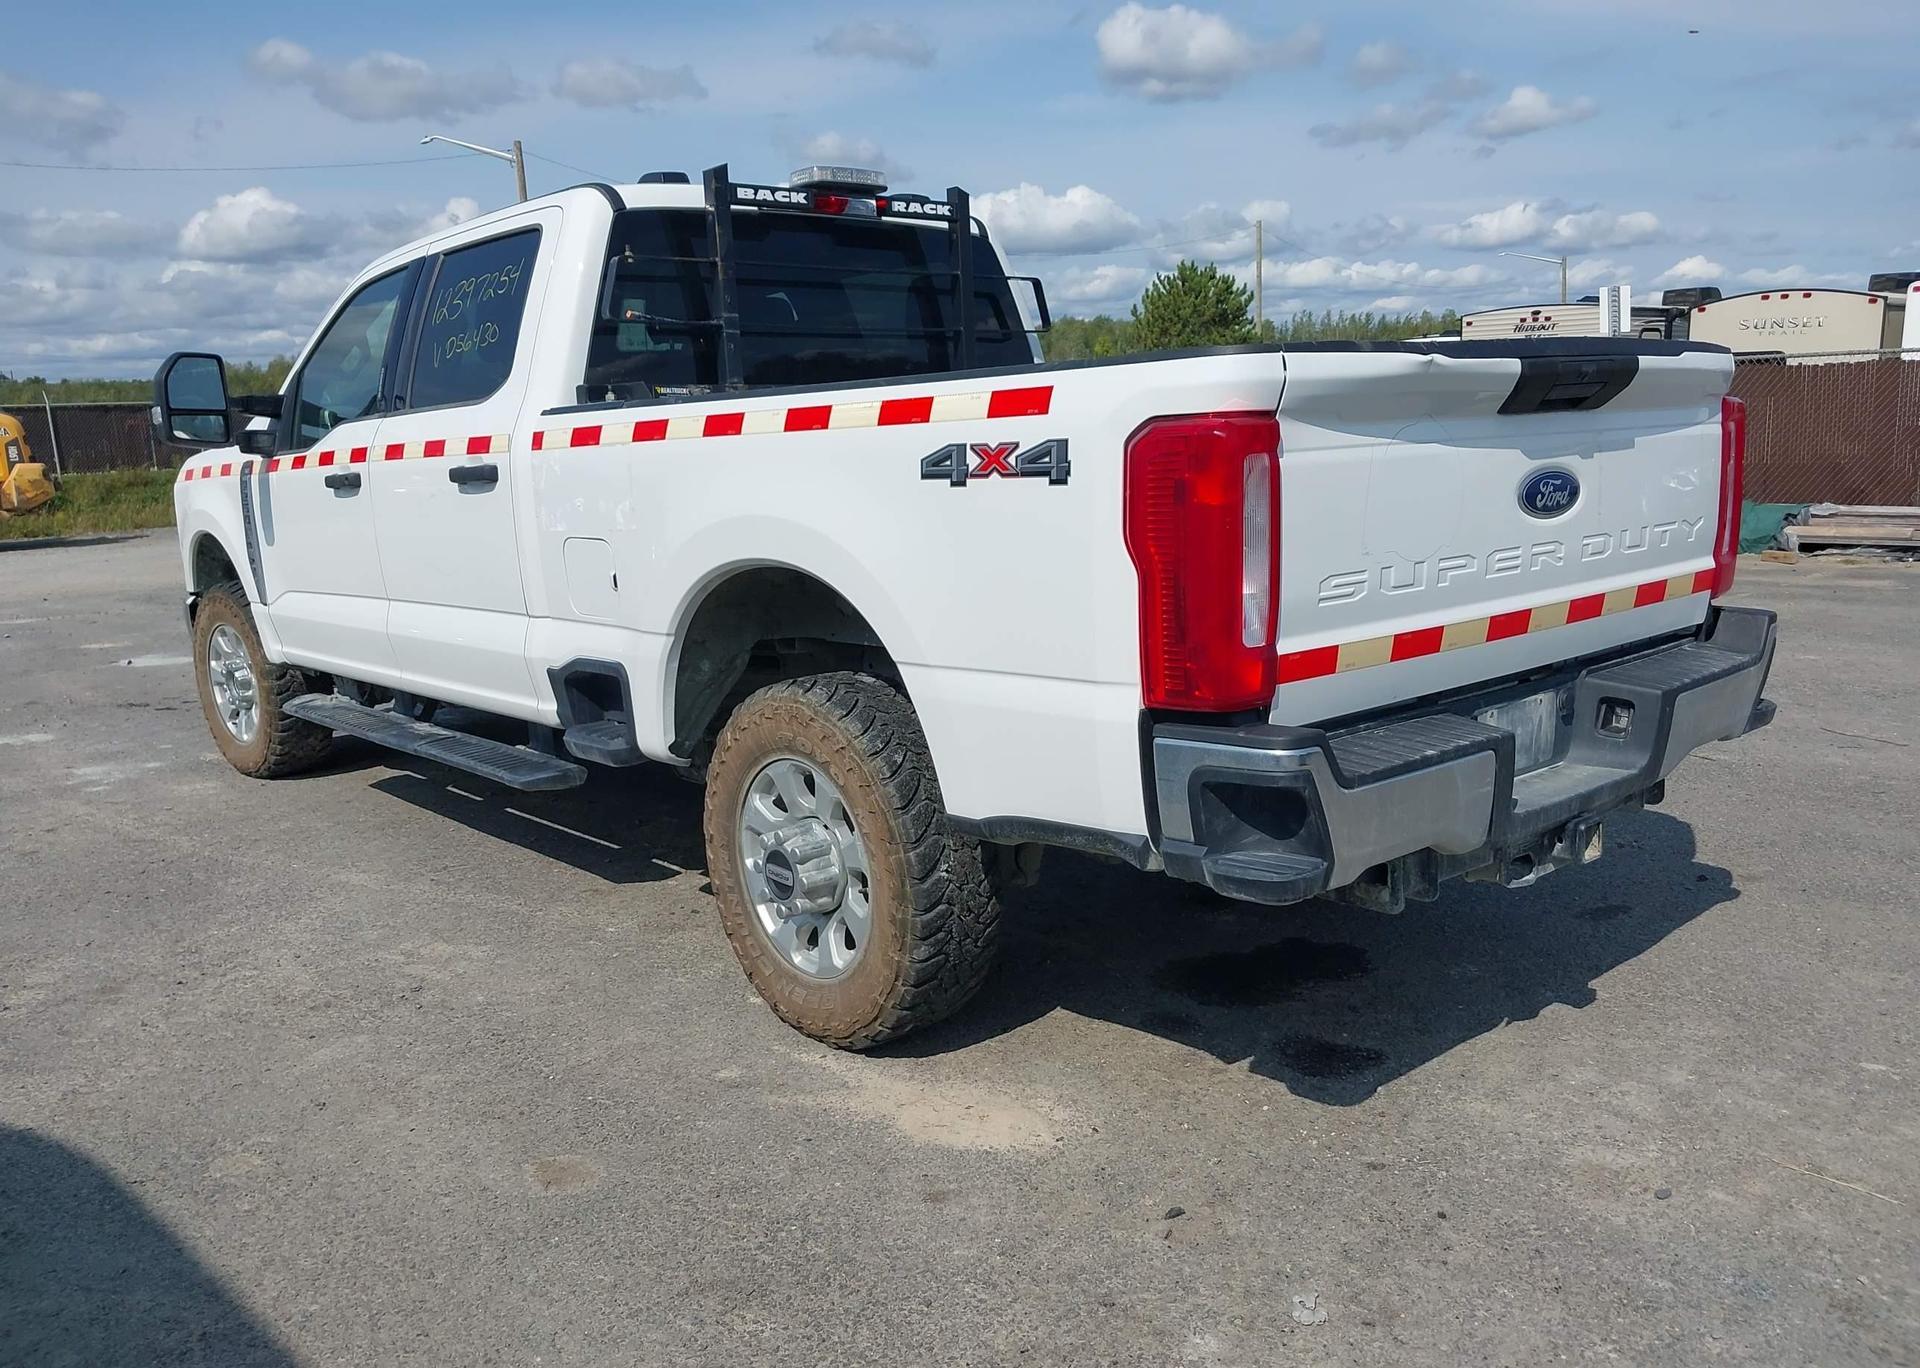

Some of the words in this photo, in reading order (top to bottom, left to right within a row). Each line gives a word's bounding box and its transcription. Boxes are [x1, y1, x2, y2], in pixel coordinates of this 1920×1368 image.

[736, 187, 808, 204] BACK
[891, 200, 952, 216] RACK
[1512, 322, 1560, 333] HIDEOUT
[1738, 315, 1826, 331] SUNSET
[1758, 329, 1809, 337] TRAIL
[1536, 478, 1570, 508] Ford
[1317, 540, 1565, 608] SUPER
[1580, 515, 1704, 563] DUTY
